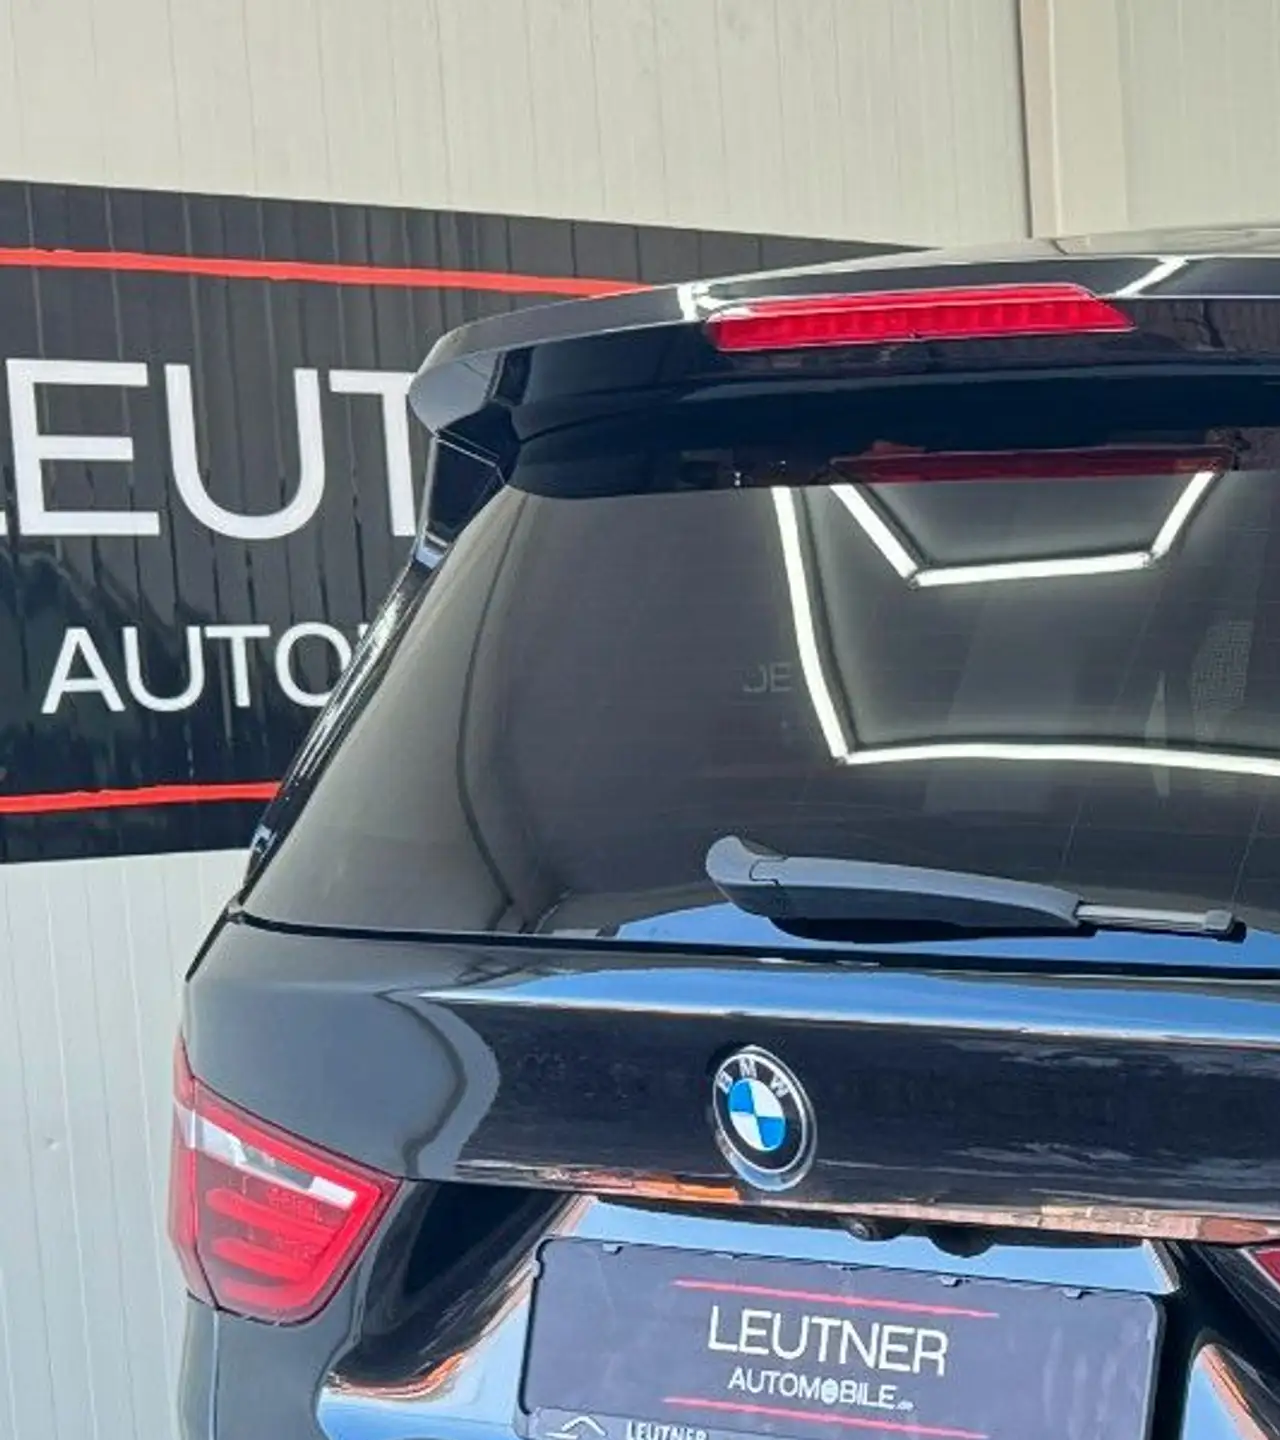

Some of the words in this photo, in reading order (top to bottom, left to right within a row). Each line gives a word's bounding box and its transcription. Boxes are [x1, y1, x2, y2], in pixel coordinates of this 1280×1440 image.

[0, 357, 418, 540] EUT
[41, 622, 371, 714] AUTO
[707, 1305, 949, 1377] LEUTNER
